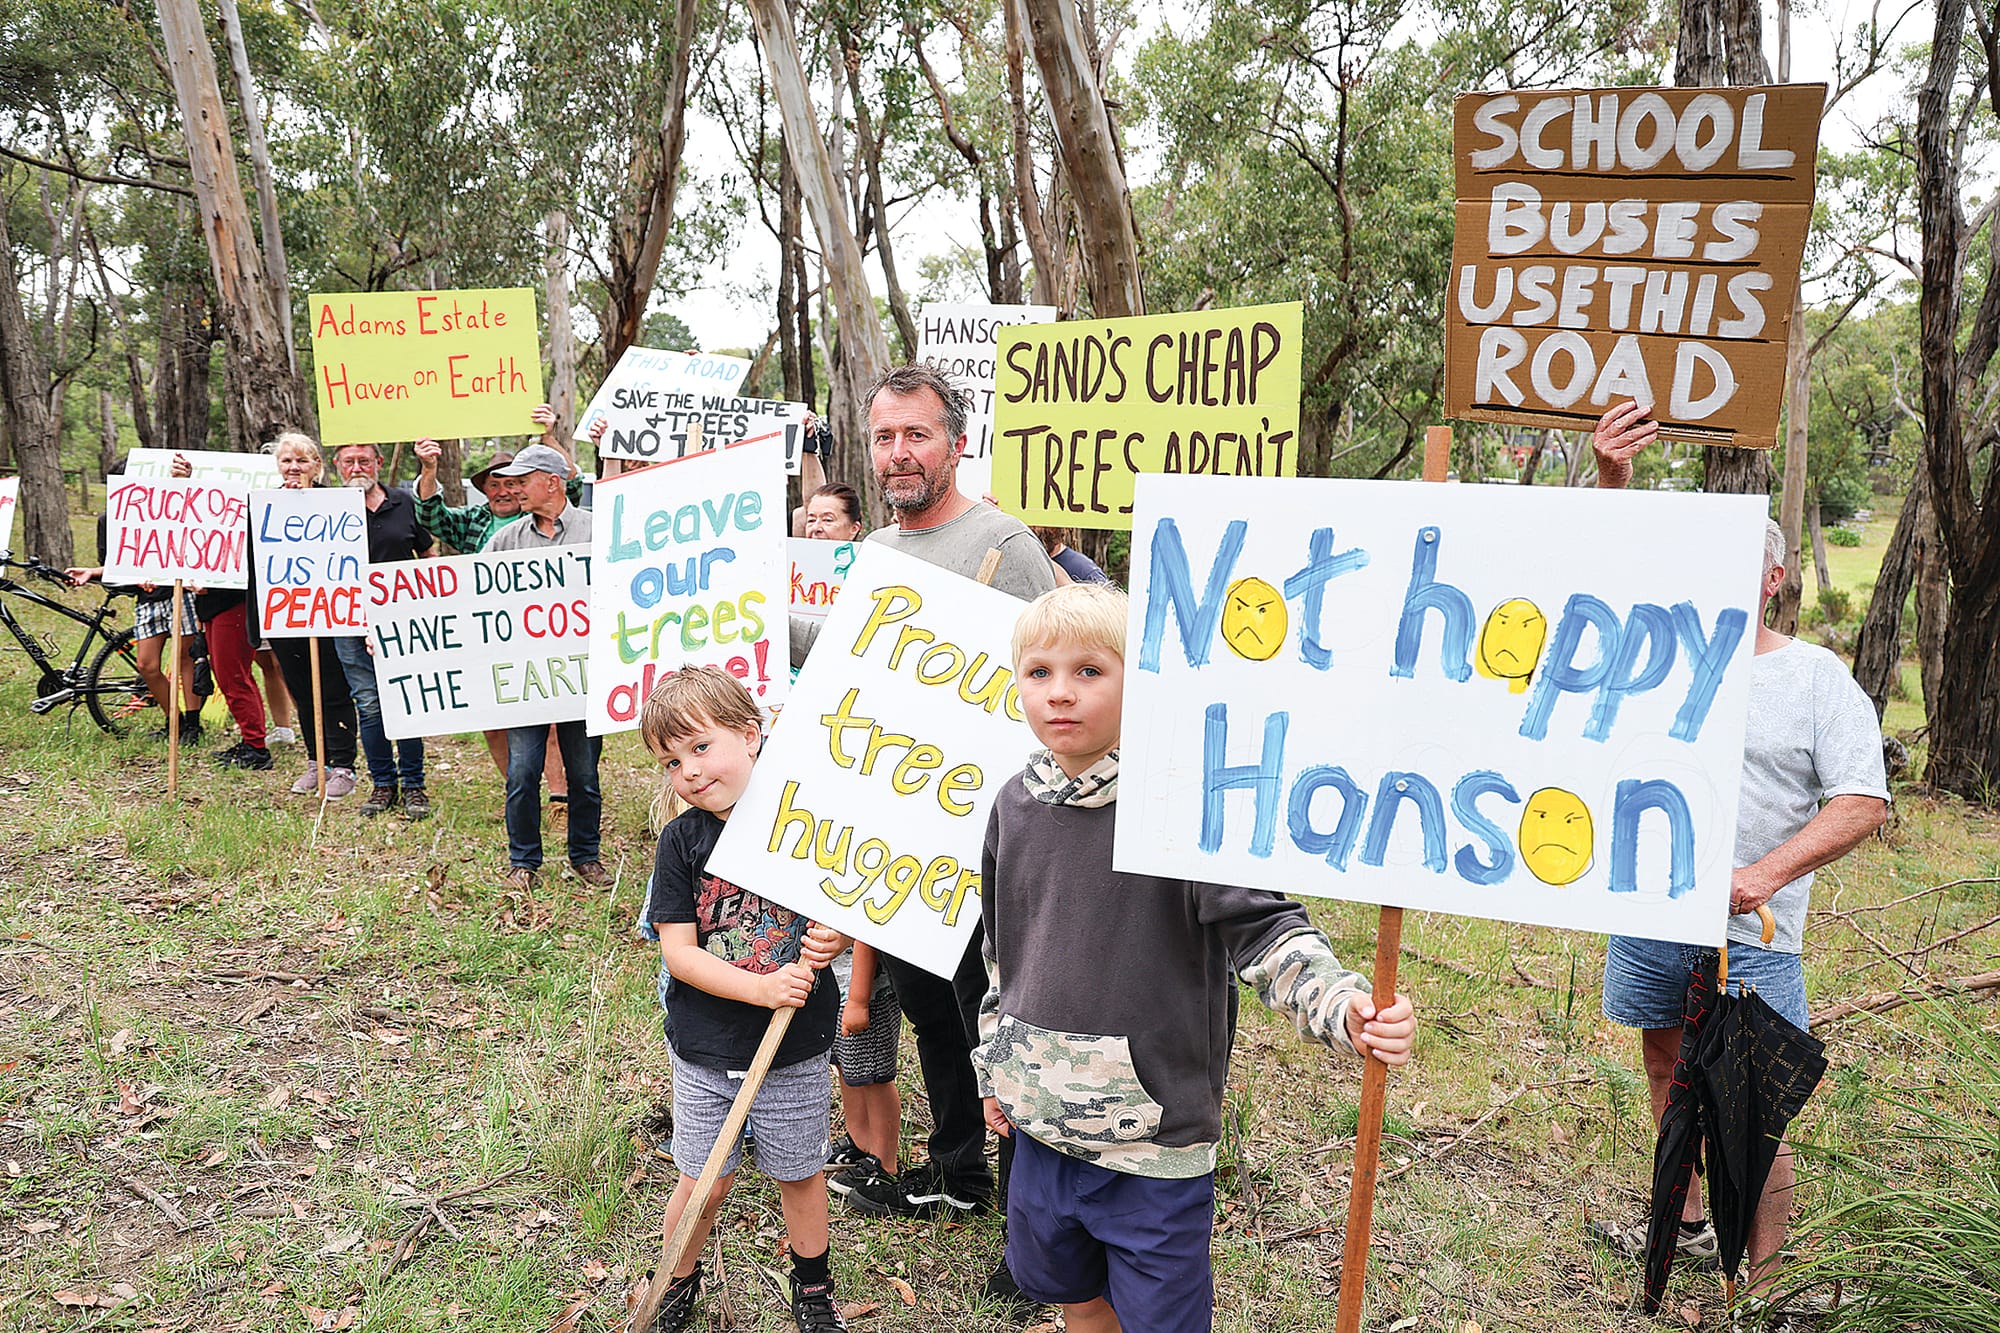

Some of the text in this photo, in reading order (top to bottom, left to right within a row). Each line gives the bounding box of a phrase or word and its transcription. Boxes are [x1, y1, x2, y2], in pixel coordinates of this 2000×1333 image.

[1468, 92, 1797, 172] SCHOOL
[1488, 182, 1764, 261] BUSES
[317, 296, 507, 339] Adams Estate
[323, 354, 528, 409] Haven on Earth
[627, 353, 740, 381] THIS ROAD
[1004, 322, 1281, 406] SAND'S CHEAP
[1475, 327, 1740, 420] ROAD
[612, 388, 791, 417] SAVE THE WILDLIFE
[611, 429, 661, 456] NO
[1003, 424, 1145, 514] TREES
[109, 482, 248, 527] TRUCK OFF
[260, 503, 363, 543] Leave
[606, 491, 762, 563] Leave
[115, 526, 245, 573] HANSON
[266, 552, 359, 584] us in
[369, 552, 592, 605] SAND DOESN'T
[630, 547, 736, 609] our
[264, 586, 368, 630] PEACE!
[375, 600, 590, 658] HAVE TO COS
[611, 590, 766, 664] trees
[388, 654, 589, 715] THE EART
[606, 639, 772, 722] ale!
[820, 688, 983, 817] tree
[767, 781, 982, 926] hugger
